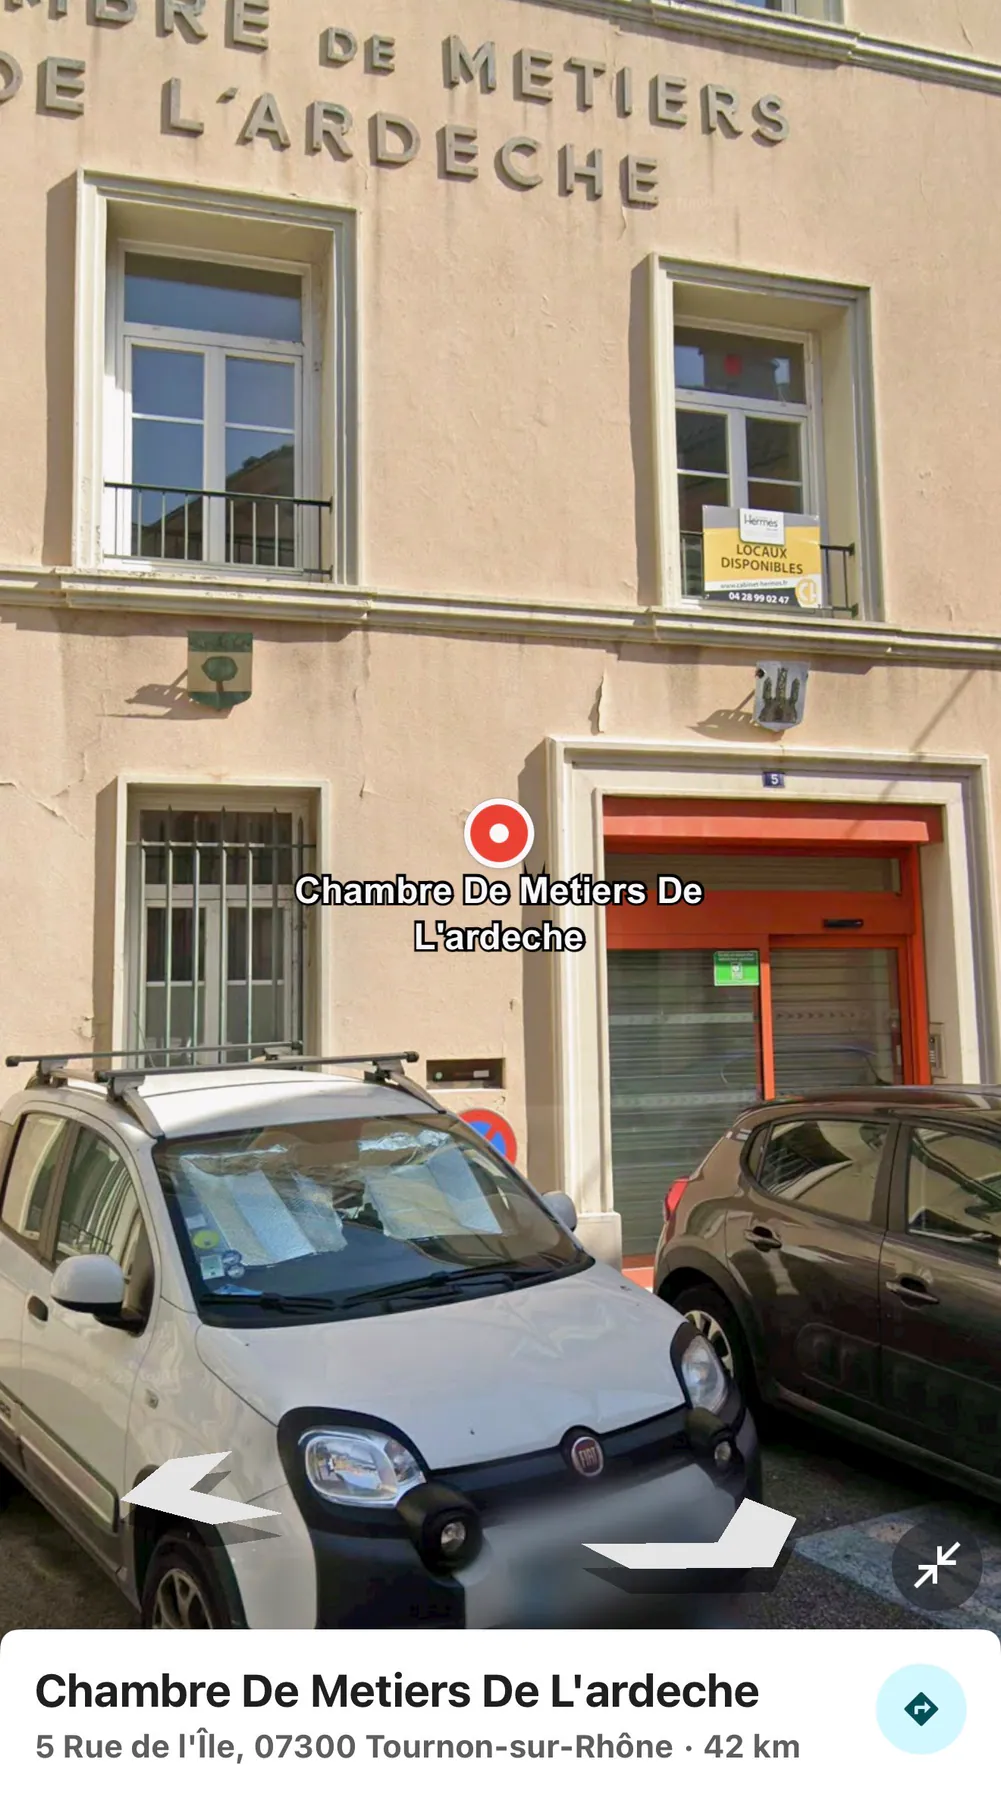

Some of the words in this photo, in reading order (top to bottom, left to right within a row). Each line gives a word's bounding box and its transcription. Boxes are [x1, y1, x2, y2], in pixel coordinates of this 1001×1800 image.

[322, 27, 395, 73] DE
[445, 34, 790, 144] METIERS
[162, 77, 660, 208] L'ARDECHE
[736, 544, 788, 559] LOCAUX
[721, 557, 804, 575] DISPONIBLES
[728, 592, 740, 601] 04
[741, 593, 753, 601] 28
[753, 594, 765, 602] 99
[766, 595, 778, 603] 02
[778, 596, 790, 604] 47
[771, 773, 779, 785] 5
[578, 1447, 599, 1468] FIAT
